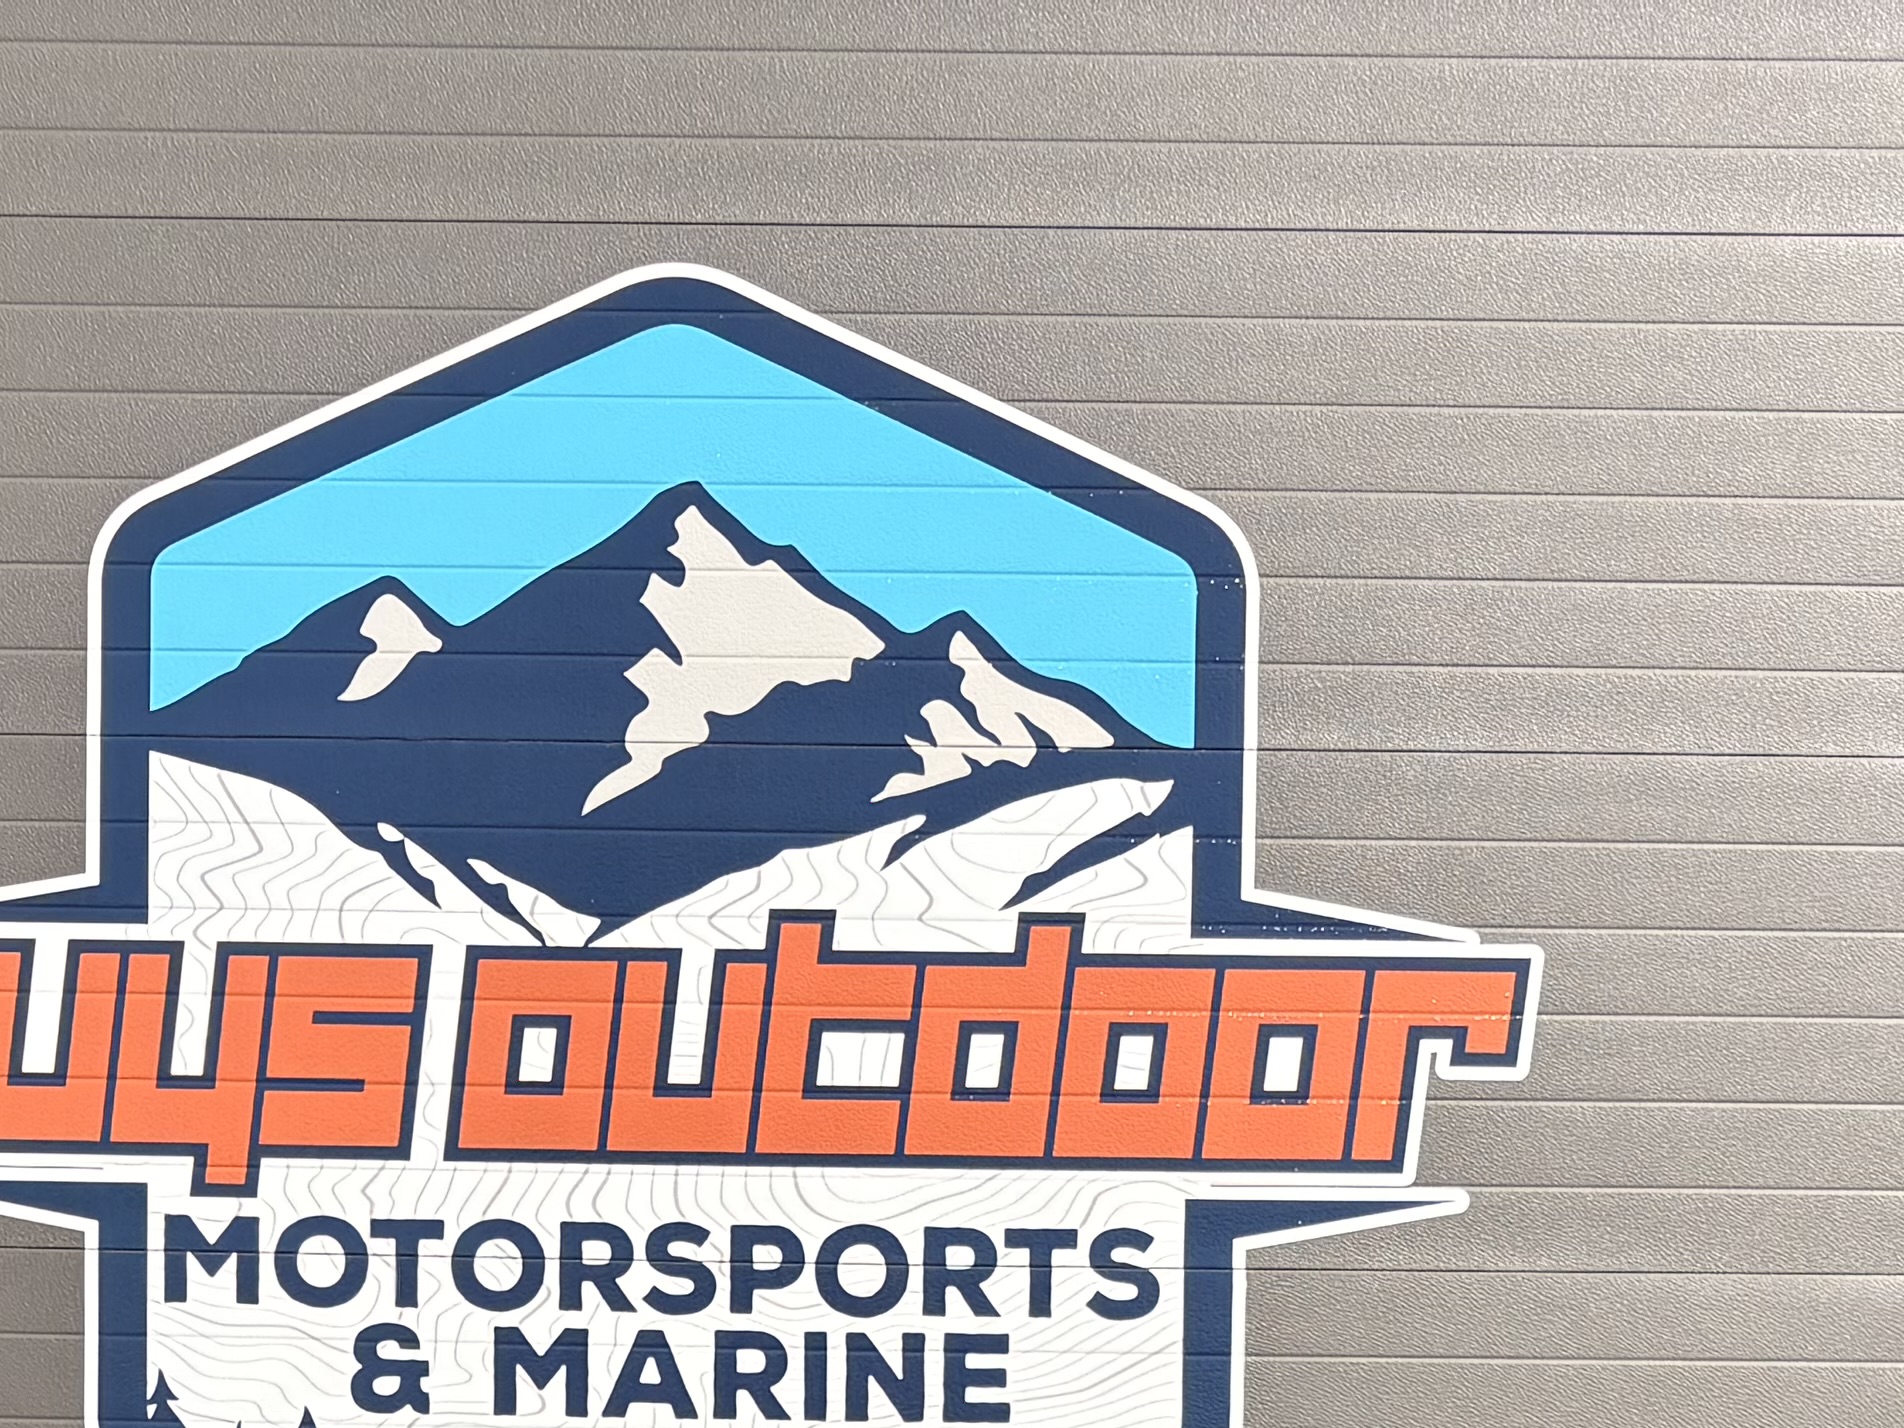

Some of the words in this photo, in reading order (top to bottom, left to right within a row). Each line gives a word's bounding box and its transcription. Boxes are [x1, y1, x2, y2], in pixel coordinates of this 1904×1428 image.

[162, 1211, 1161, 1322] MOTORSPORTS
[349, 1332, 431, 1415] &
[491, 1329, 1013, 1424] MARINE
